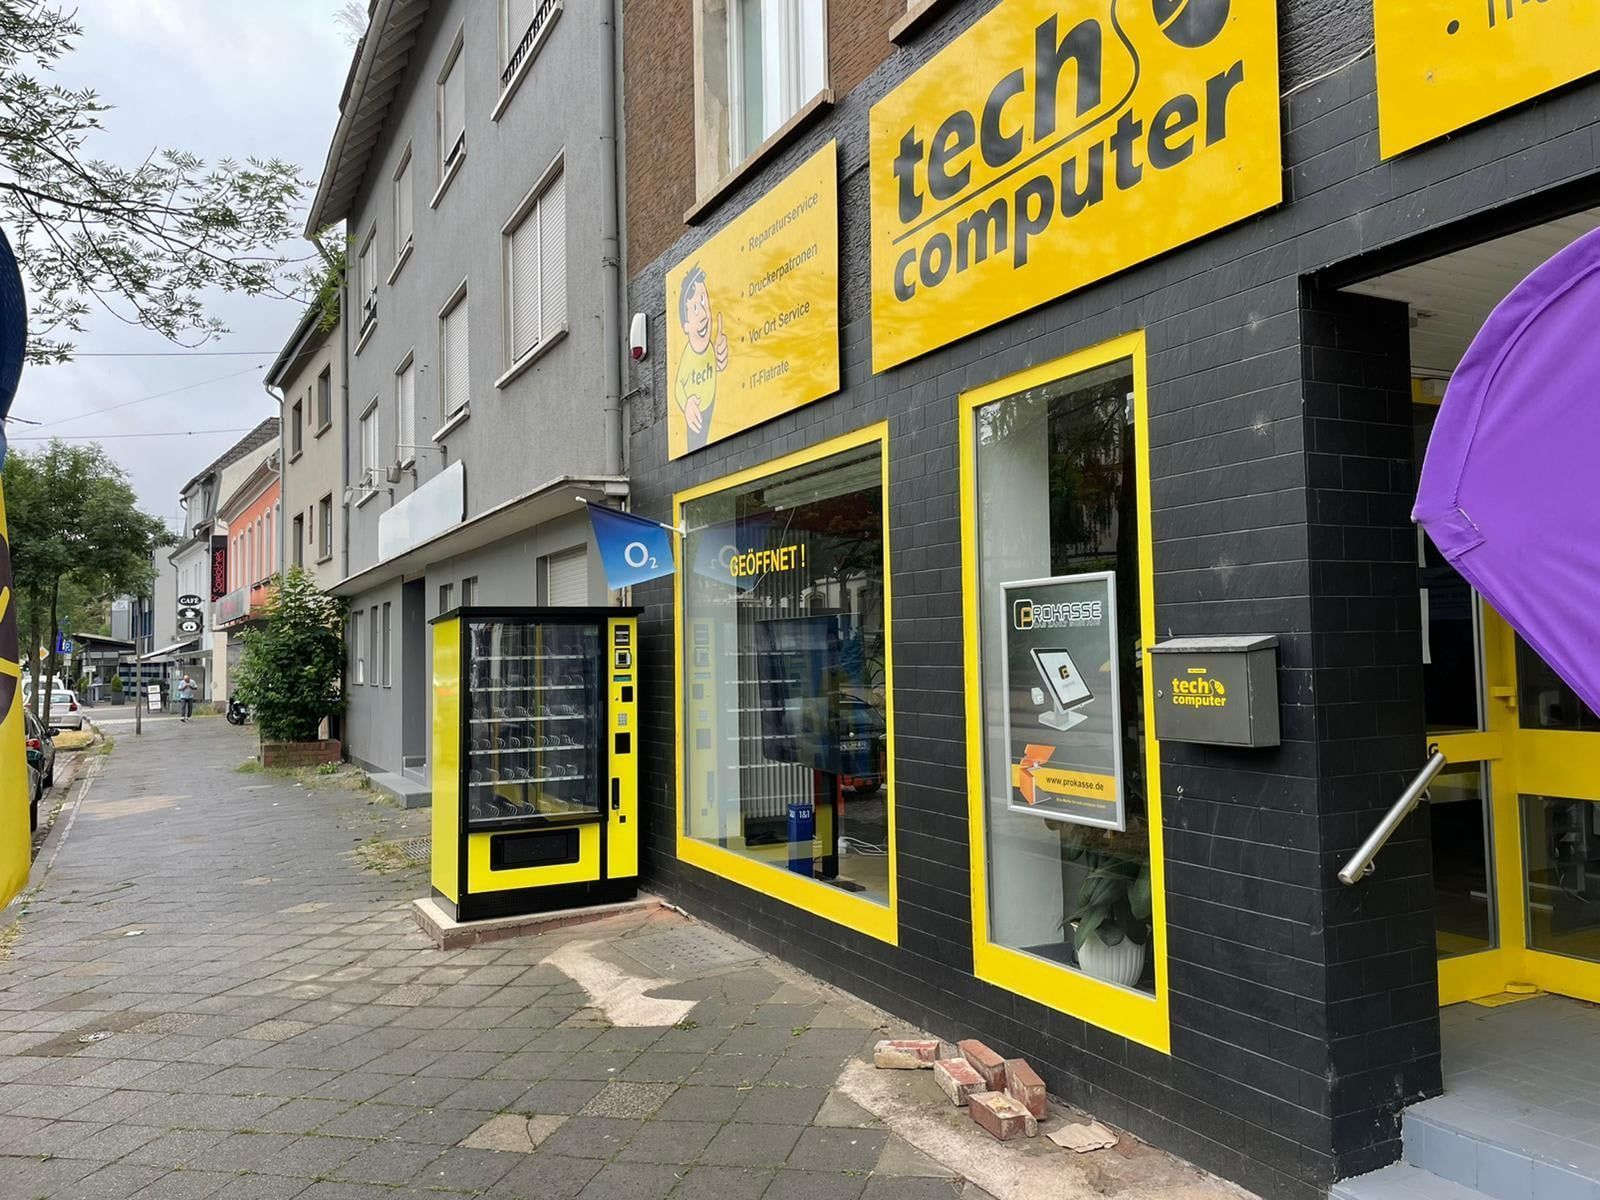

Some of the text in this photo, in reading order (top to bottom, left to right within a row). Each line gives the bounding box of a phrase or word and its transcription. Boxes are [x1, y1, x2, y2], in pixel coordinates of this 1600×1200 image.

[893, 13, 1102, 225] tech
[893, 60, 1244, 303] computer
[749, 192, 819, 251] Reparaturservice
[749, 243, 818, 297] Druckerpatronen
[749, 301, 810, 344] Vor Ort Service
[691, 363, 713, 385] tech
[750, 360, 790, 389] IT-Flatrate
[729, 545, 797, 577] GEÖFFNET
[180, 596, 200, 604] CAFÉ
[1014, 599, 1102, 630] PROKASSE
[1172, 677, 1210, 694] tech
[1172, 695, 1227, 709] computer
[1046, 777, 1104, 791] www.prokasse.de
